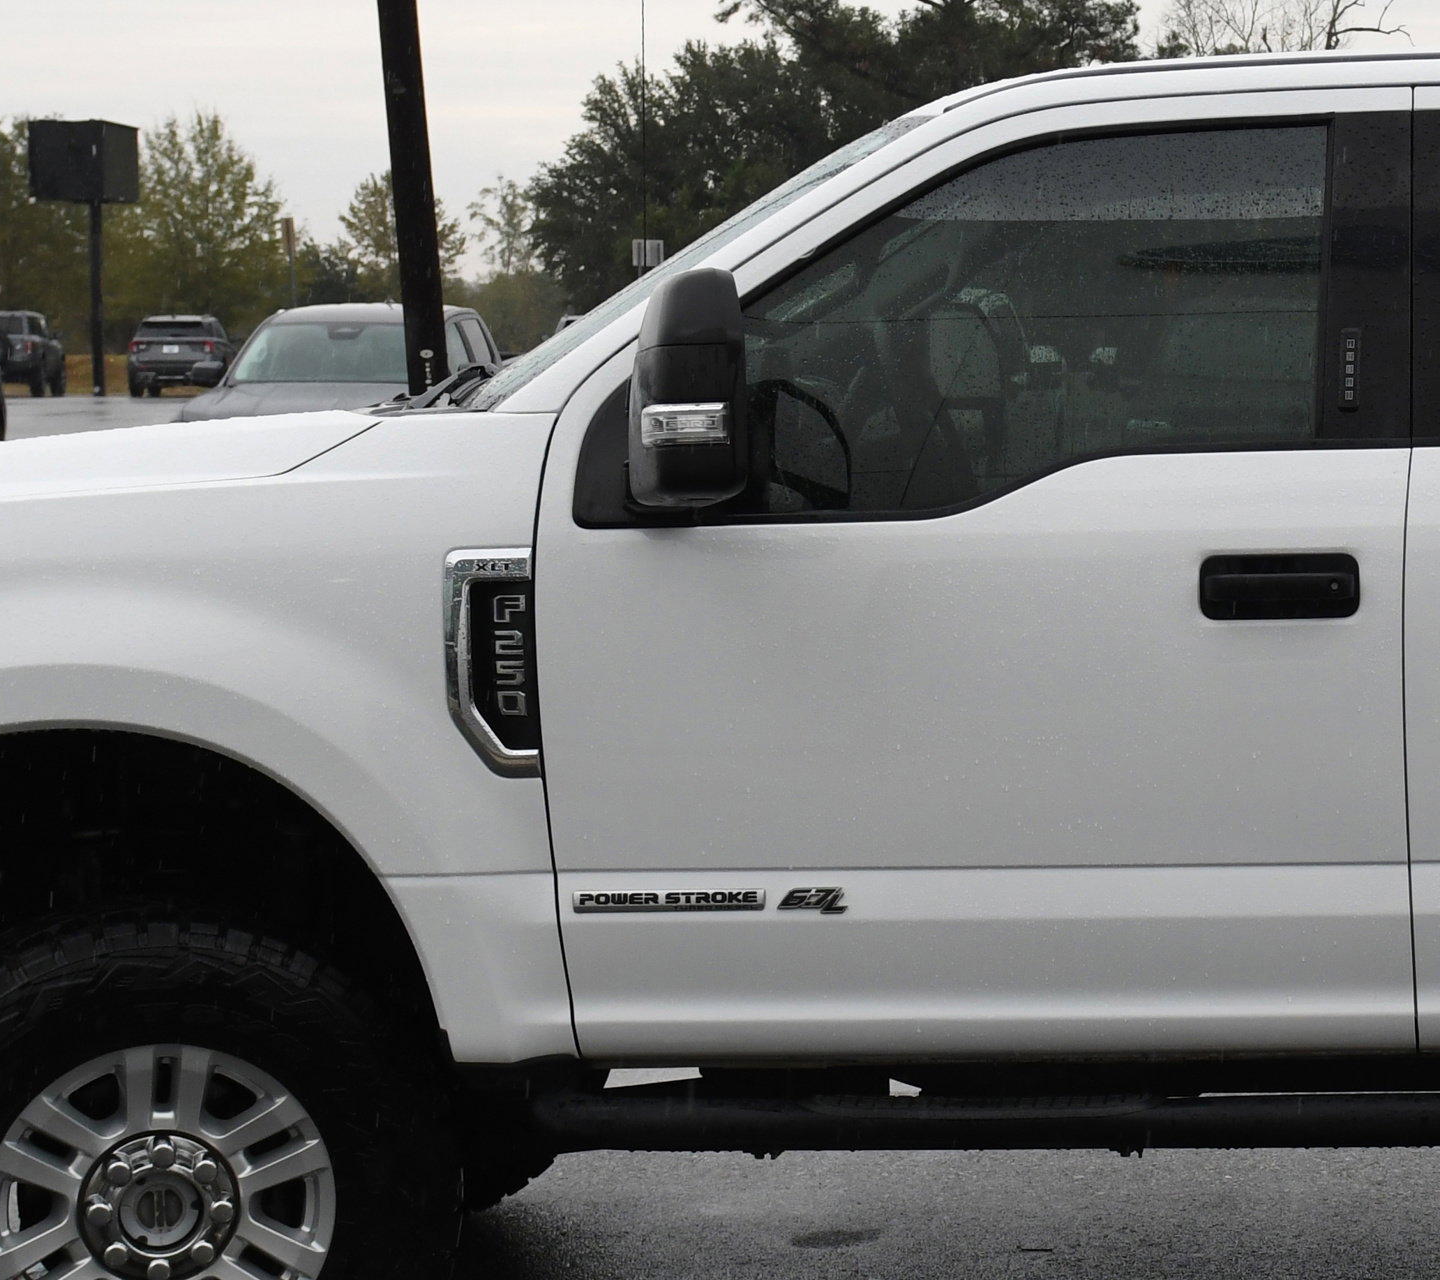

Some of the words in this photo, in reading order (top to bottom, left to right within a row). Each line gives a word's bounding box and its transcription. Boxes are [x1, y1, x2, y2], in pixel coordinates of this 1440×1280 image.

[476, 562, 511, 572] XLT
[493, 594, 528, 717] F250
[579, 892, 659, 906] POWER
[665, 890, 758, 904] STROKE
[777, 886, 849, 914] 6.7L
